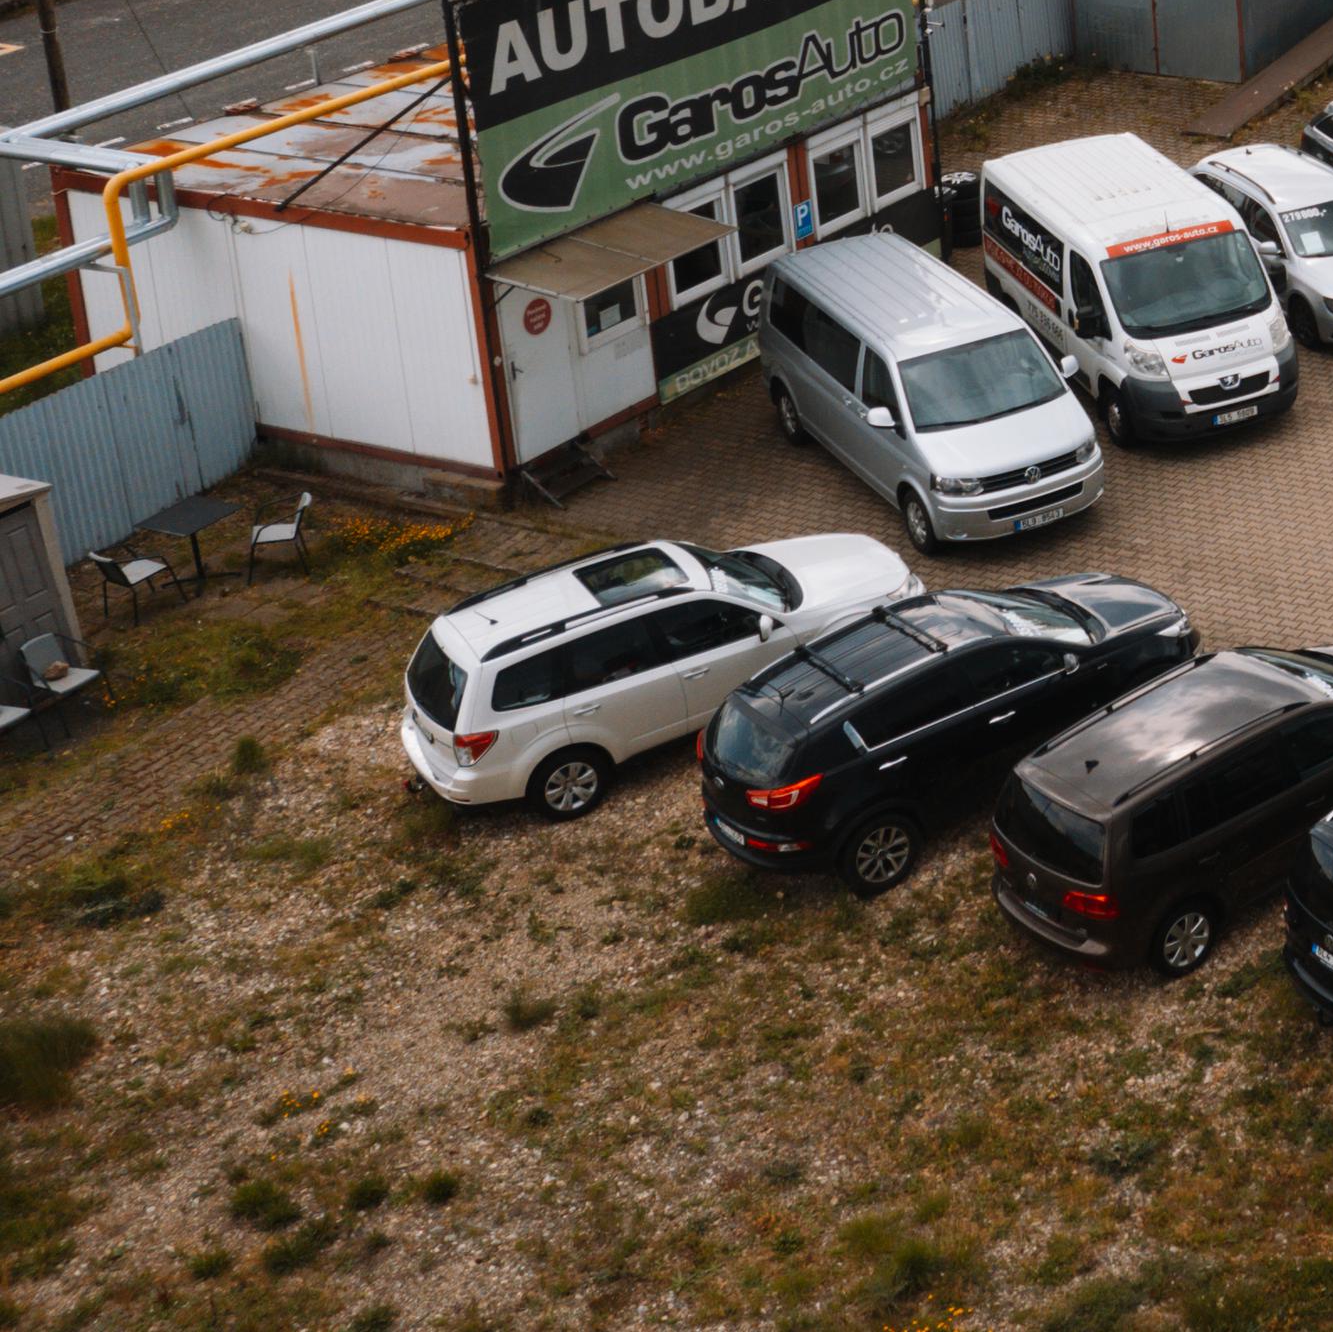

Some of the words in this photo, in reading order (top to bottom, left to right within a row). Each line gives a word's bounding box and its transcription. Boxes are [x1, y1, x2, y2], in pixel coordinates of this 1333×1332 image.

[616, 9, 906, 165] GarosAuto
[625, 58, 908, 190] www.garos-auto.cz
[797, 204, 808, 227] P
[1002, 205, 1061, 272] GarosAuto
[1123, 224, 1219, 253] www.garos-auto.cz
[675, 347, 740, 392] DOVOZ
[1192, 336, 1263, 361] GarosAuto
